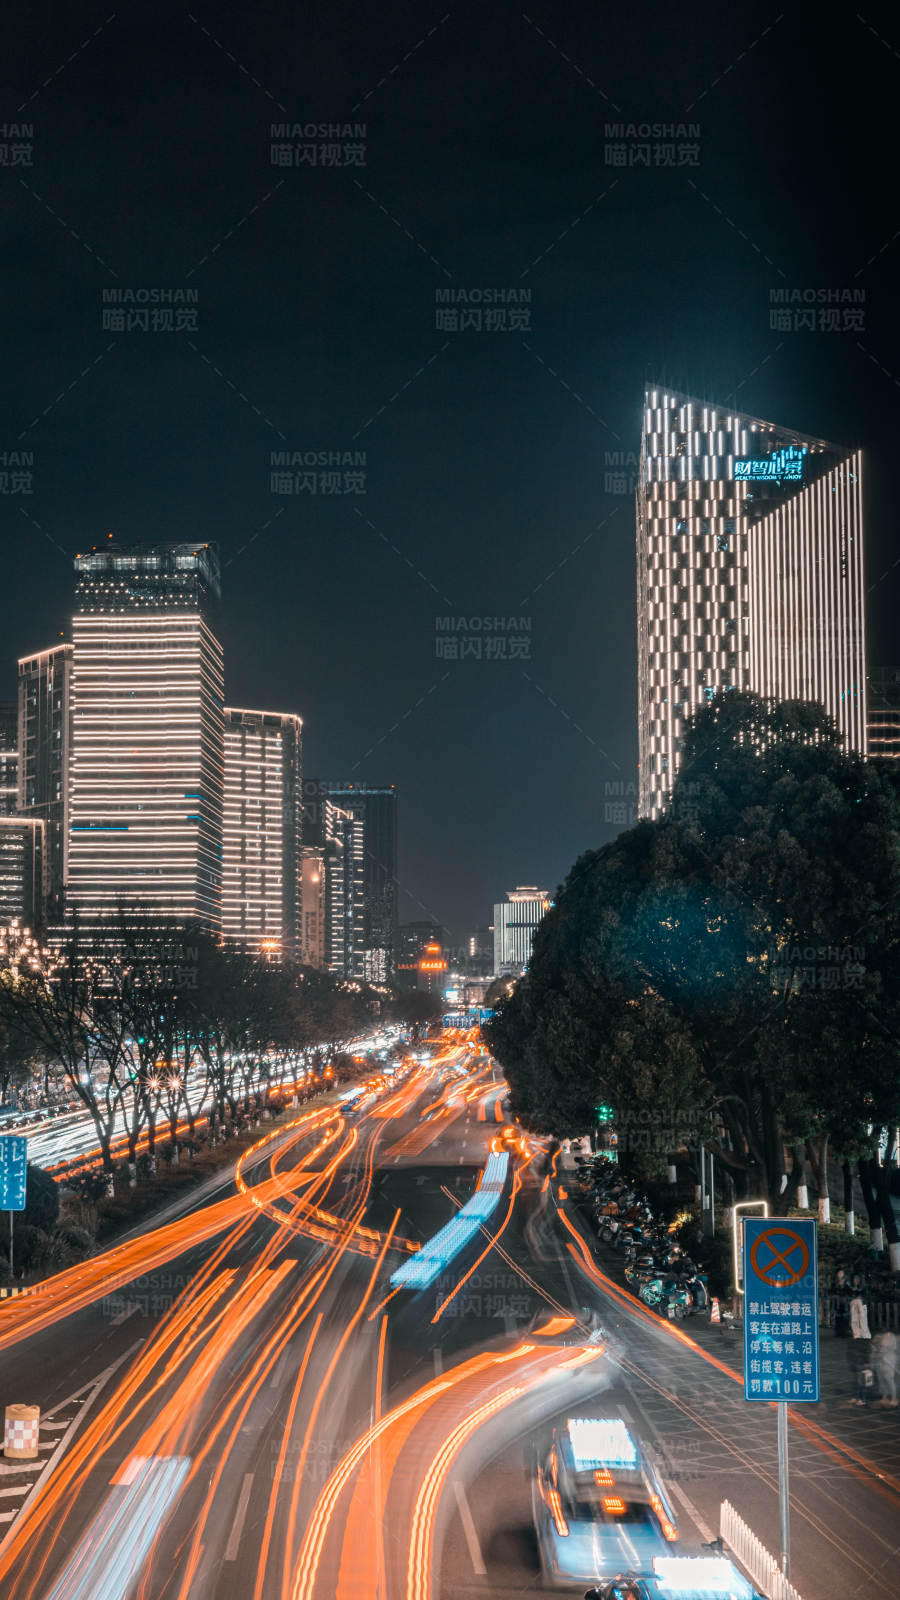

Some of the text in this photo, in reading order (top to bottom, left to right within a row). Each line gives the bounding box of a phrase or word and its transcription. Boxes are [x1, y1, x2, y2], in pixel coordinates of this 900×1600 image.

[749, 1301, 812, 1316] 禁止驾驶营运
[749, 1321, 812, 1336] 客车在道路上
[750, 1340, 813, 1355] 停车等候、沿
[751, 1378, 814, 1394] 罚款100元
